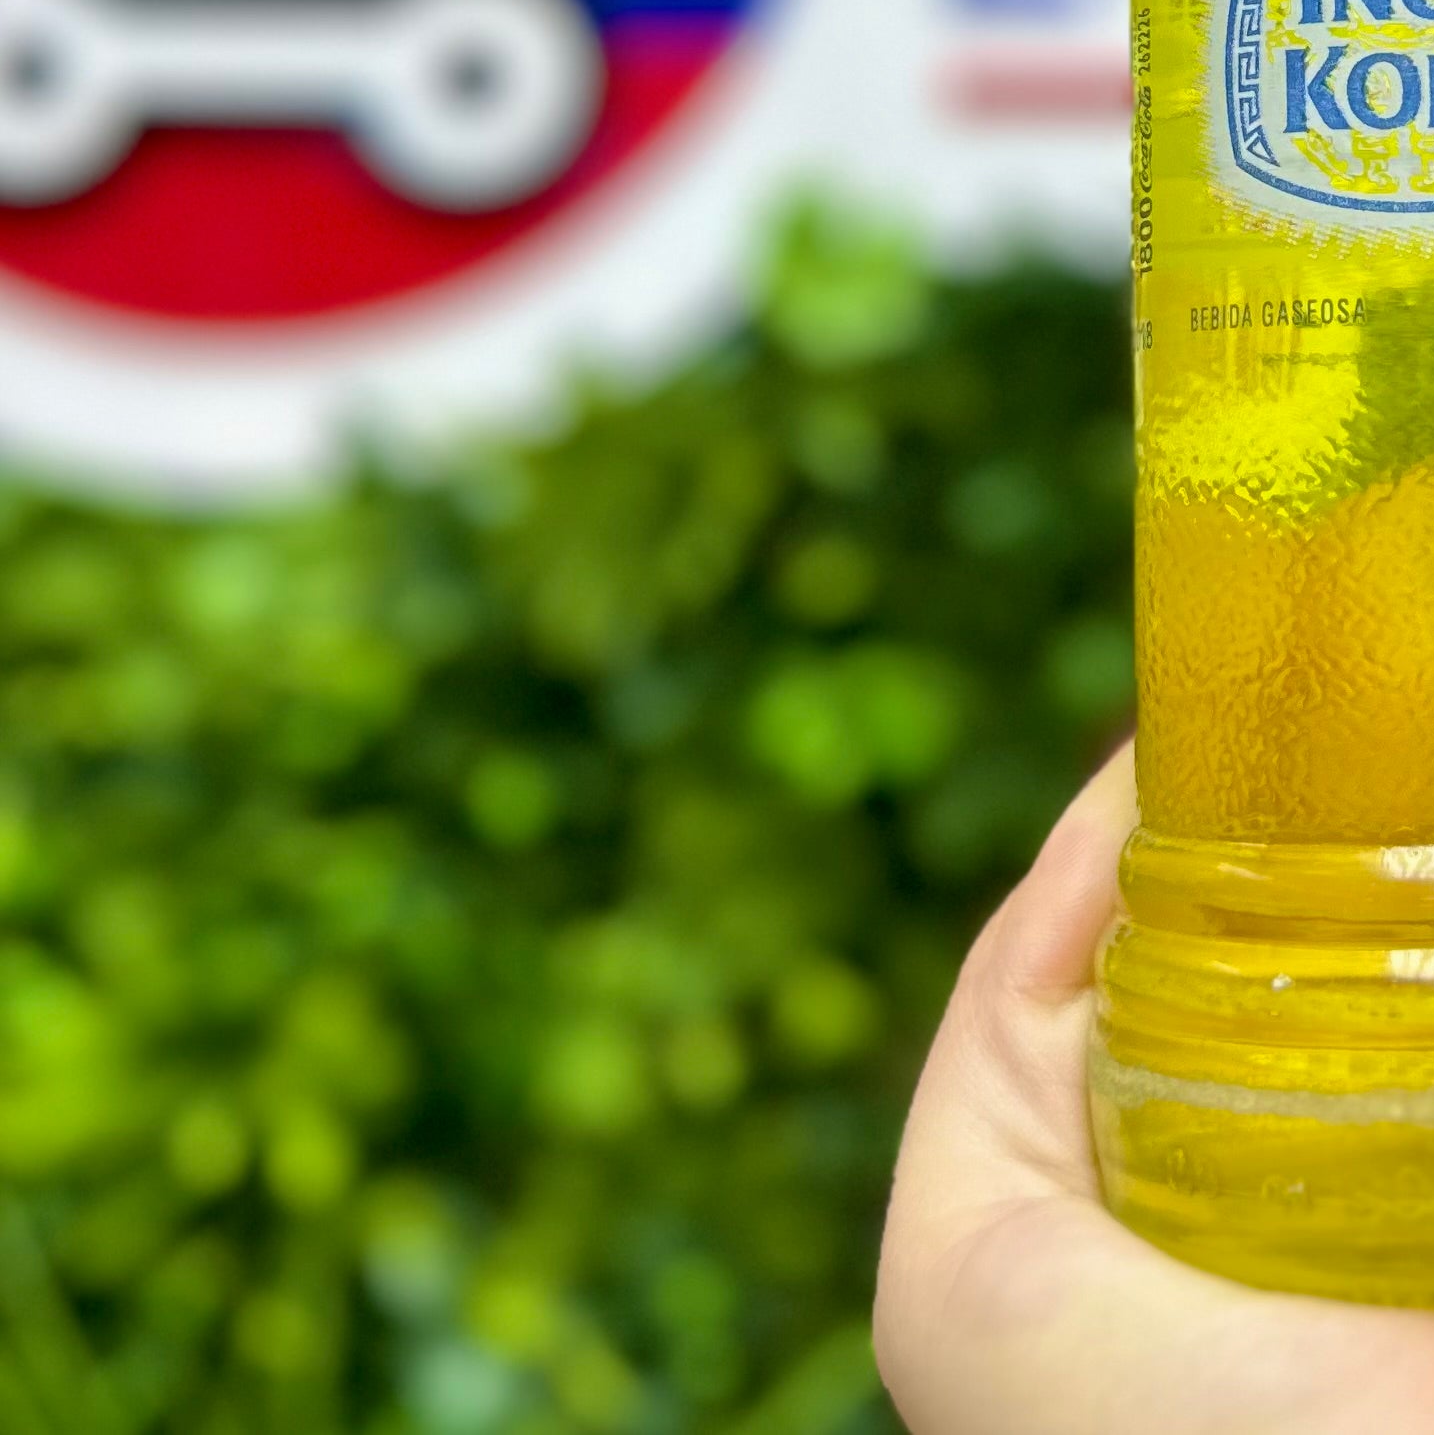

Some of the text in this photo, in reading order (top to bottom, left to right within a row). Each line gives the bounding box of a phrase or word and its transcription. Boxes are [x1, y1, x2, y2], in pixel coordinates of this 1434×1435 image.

[1137, 7, 1151, 76] 262226
[1138, 197, 1153, 279] 1800
[1190, 297, 1367, 332] BEBIDA GASEOSA
